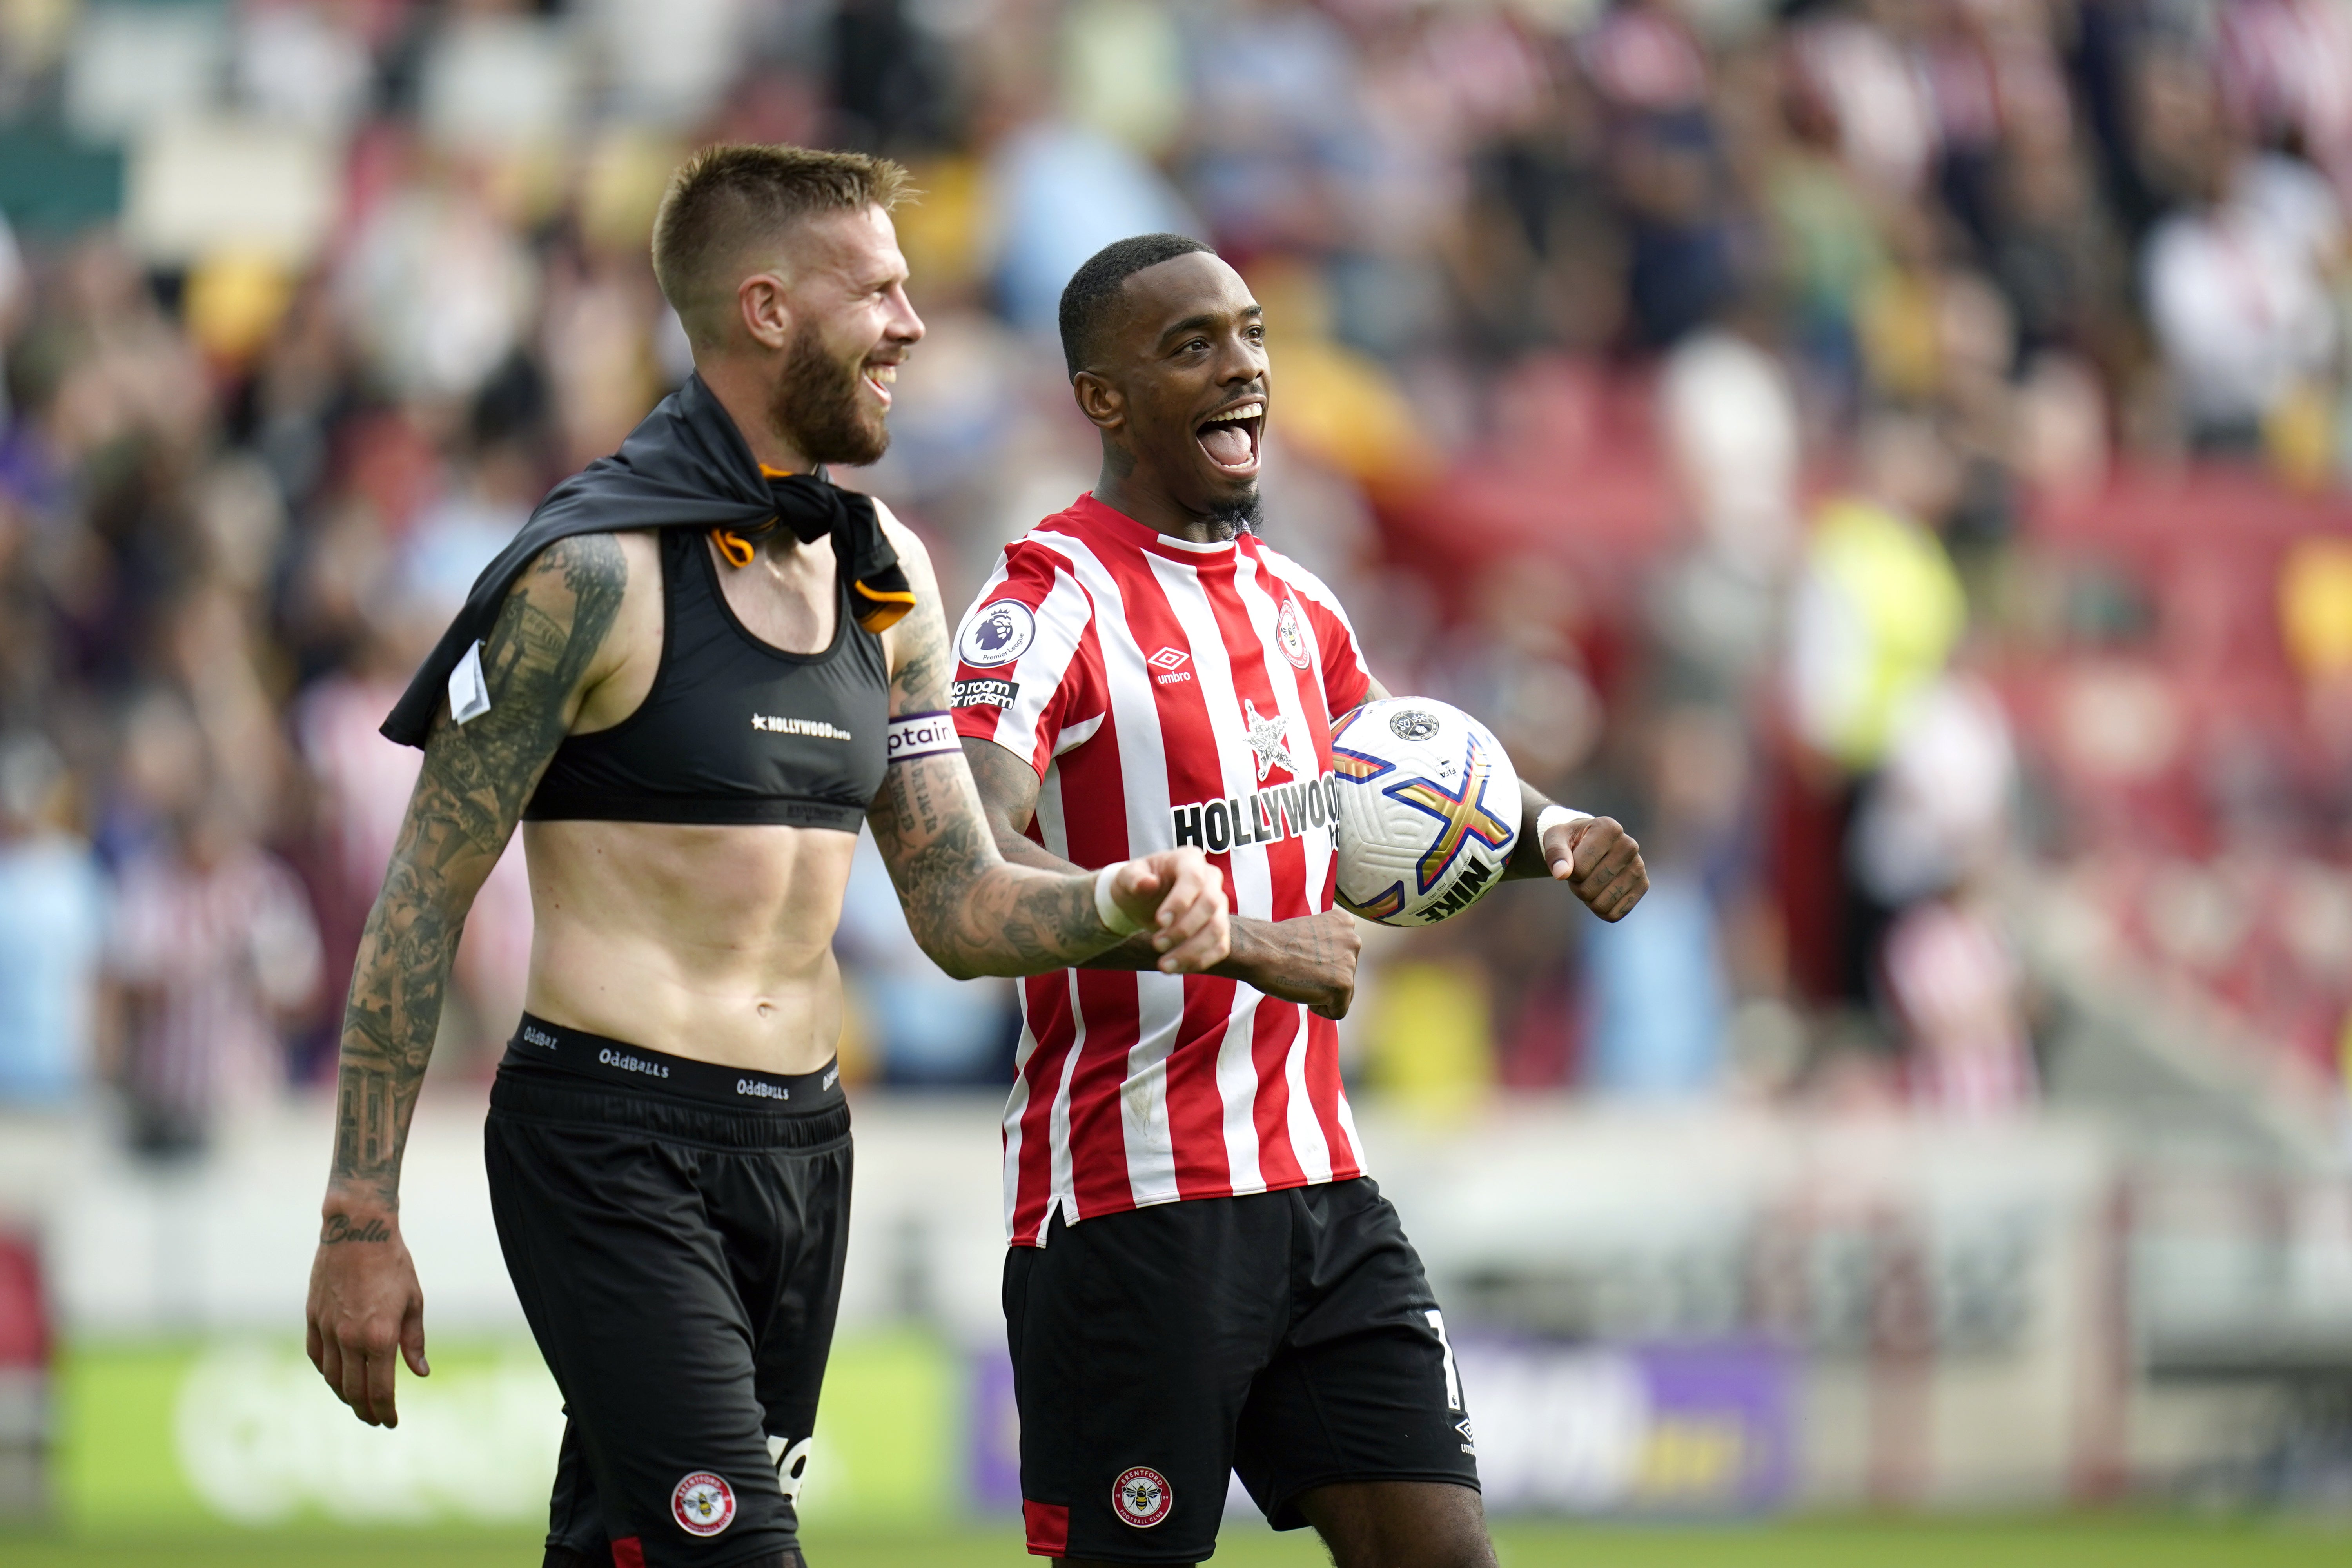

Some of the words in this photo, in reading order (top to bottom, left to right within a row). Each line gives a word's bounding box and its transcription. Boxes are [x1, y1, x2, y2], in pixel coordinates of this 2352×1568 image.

[983, 651, 1007, 660] Premier
[1007, 633, 1024, 653] League
[1158, 671, 1191, 684] umbro
[967, 681, 1010, 695] room
[963, 692, 1014, 709] racism
[1439, 768, 1456, 778] FIFA
[1174, 774, 1339, 851] HOLLYWOO
[1451, 871, 1461, 884] MATCH
[1415, 855, 1492, 922] NIKE
[1428, 882, 1447, 900] 2022-2023
[320, 1213, 391, 1245] Bella
[1461, 1443, 1474, 1455] umb
[1121, 1470, 1163, 1485] BRENTFORD
[1120, 1509, 1147, 1524] FOOTBALL
[1149, 1511, 1163, 1521] CLUB
